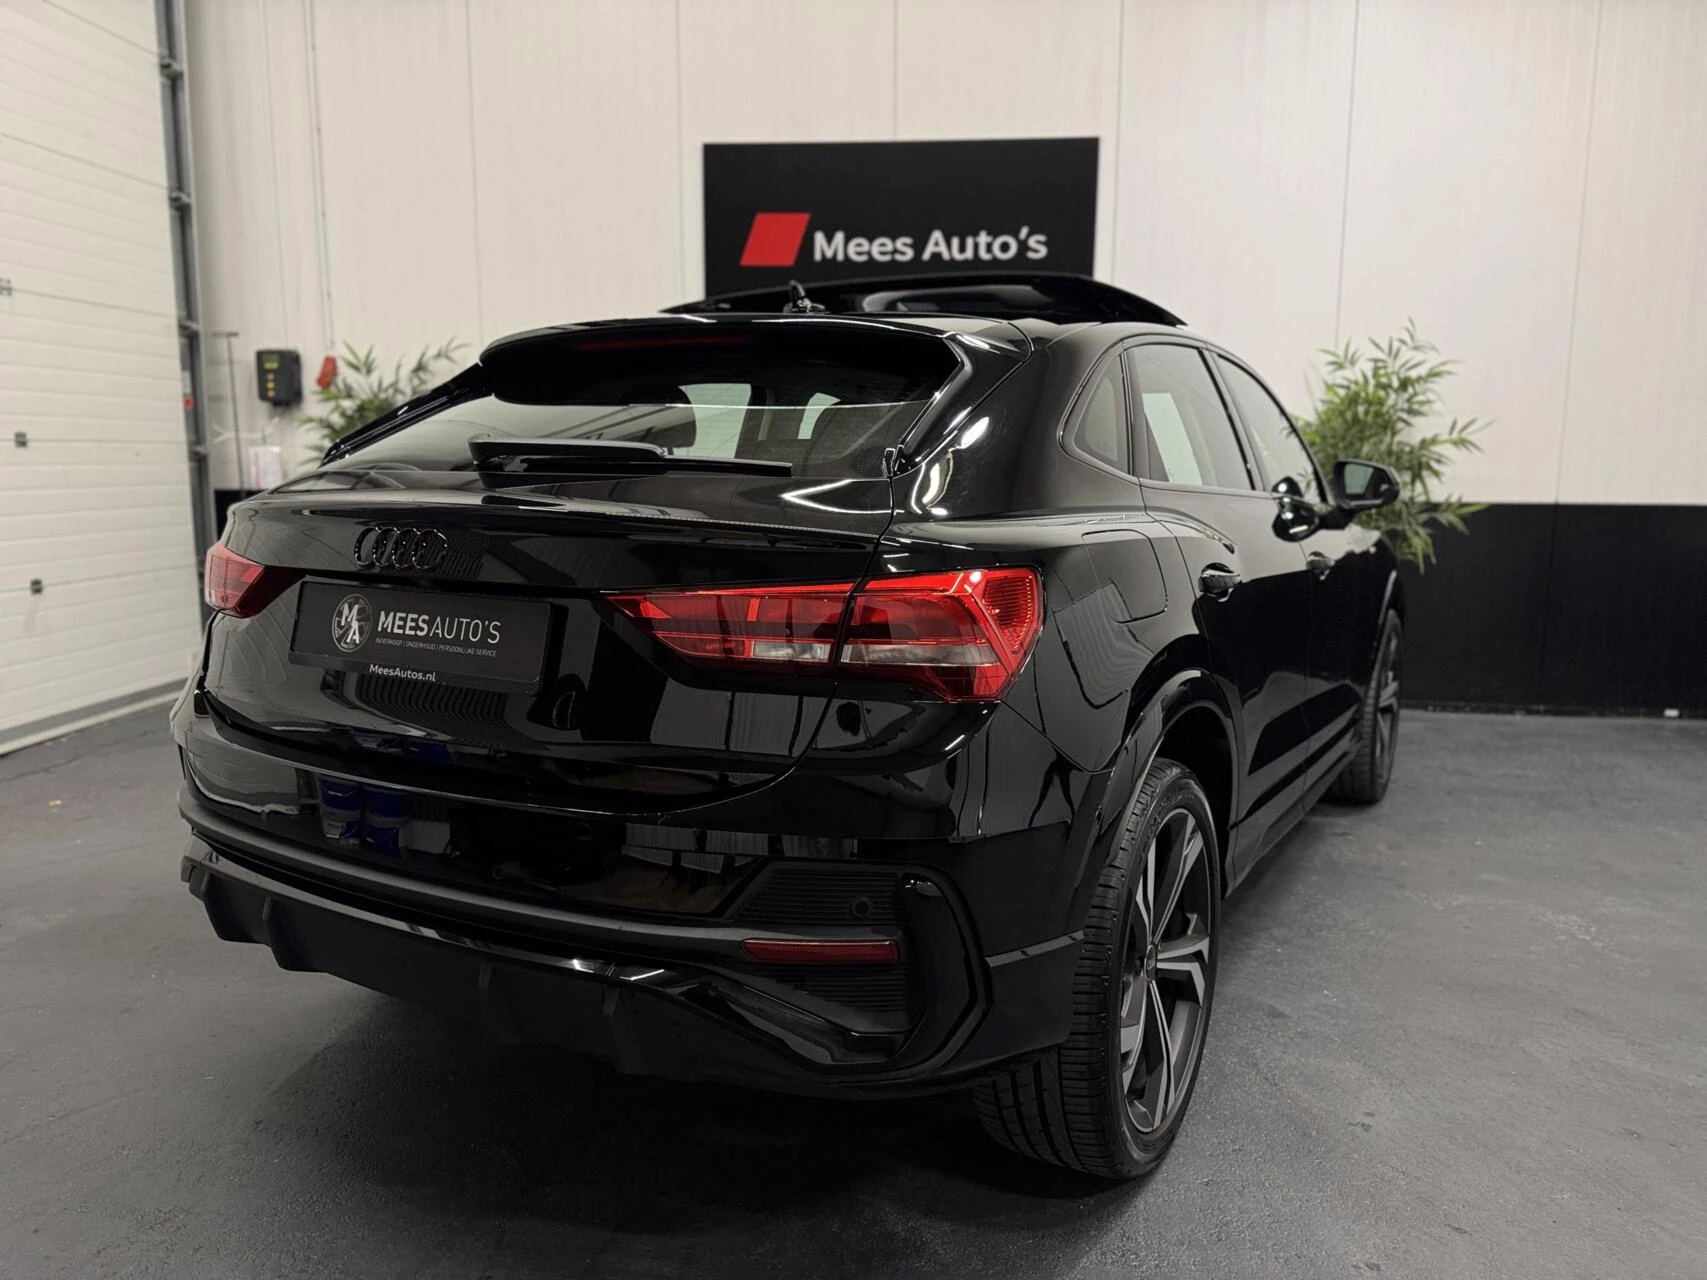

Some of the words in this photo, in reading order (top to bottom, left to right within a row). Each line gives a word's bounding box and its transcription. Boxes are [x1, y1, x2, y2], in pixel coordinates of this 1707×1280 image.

[813, 230, 915, 263] Mees
[922, 225, 1049, 262] Auto's
[369, 664, 436, 682] MeesAutos.nl
